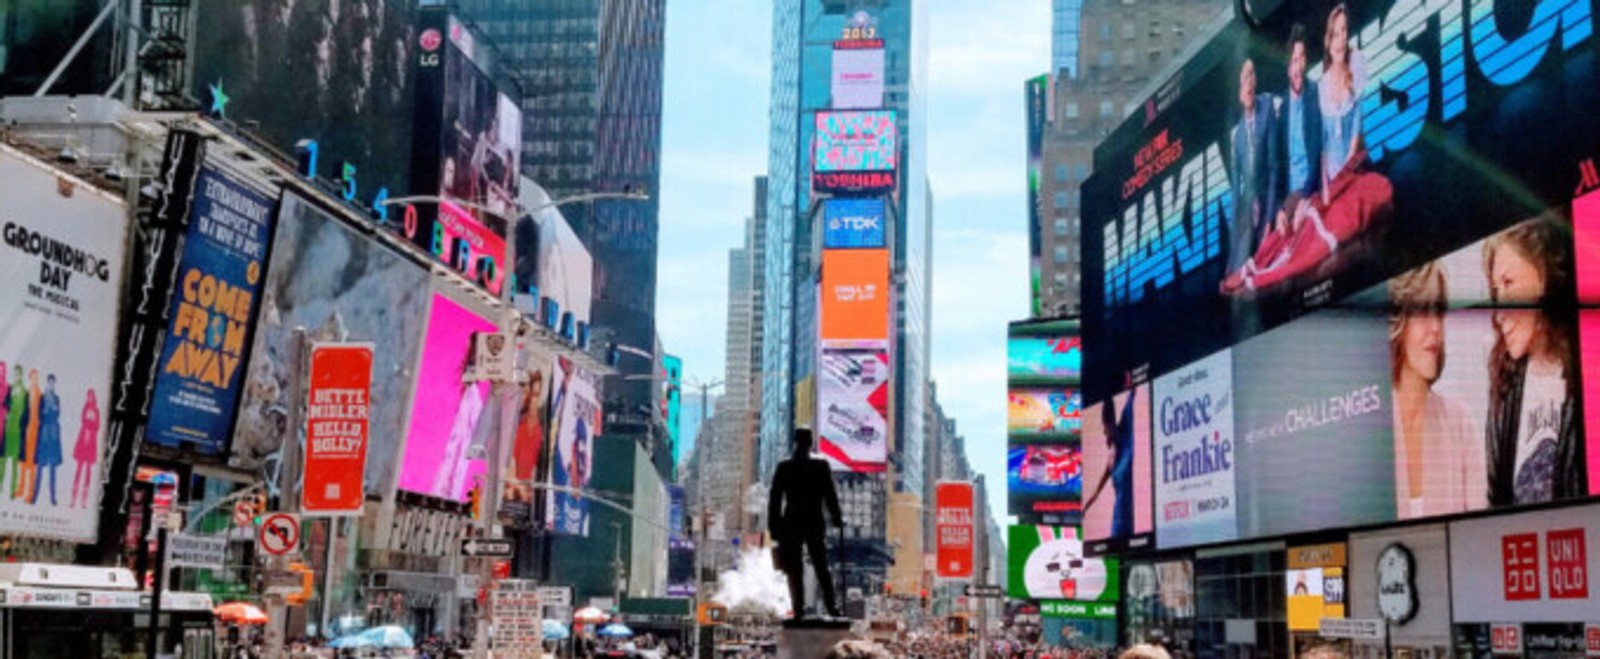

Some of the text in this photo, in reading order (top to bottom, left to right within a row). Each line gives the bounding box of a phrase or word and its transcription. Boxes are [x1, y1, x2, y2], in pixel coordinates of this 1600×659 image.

[842, 28, 876, 39] 2017
[420, 54, 439, 66] LG
[815, 173, 893, 188] TOSHIBA
[842, 217, 880, 230] TDK
[3, 221, 110, 283] GROUNDHOG
[40, 261, 72, 292] DAY
[183, 268, 252, 323] COME
[173, 301, 247, 354] FROM
[165, 340, 240, 389] AWAY
[315, 388, 365, 404] BETTE
[1285, 384, 1381, 433] CHALLENGES
[310, 404, 370, 419] MIDLER
[1160, 393, 1212, 436] Grace
[1163, 431, 1231, 483] Frankie
[1551, 537, 1580, 562] UNI
[1553, 566, 1583, 596] QLO
[1057, 604, 1086, 614] SOON
